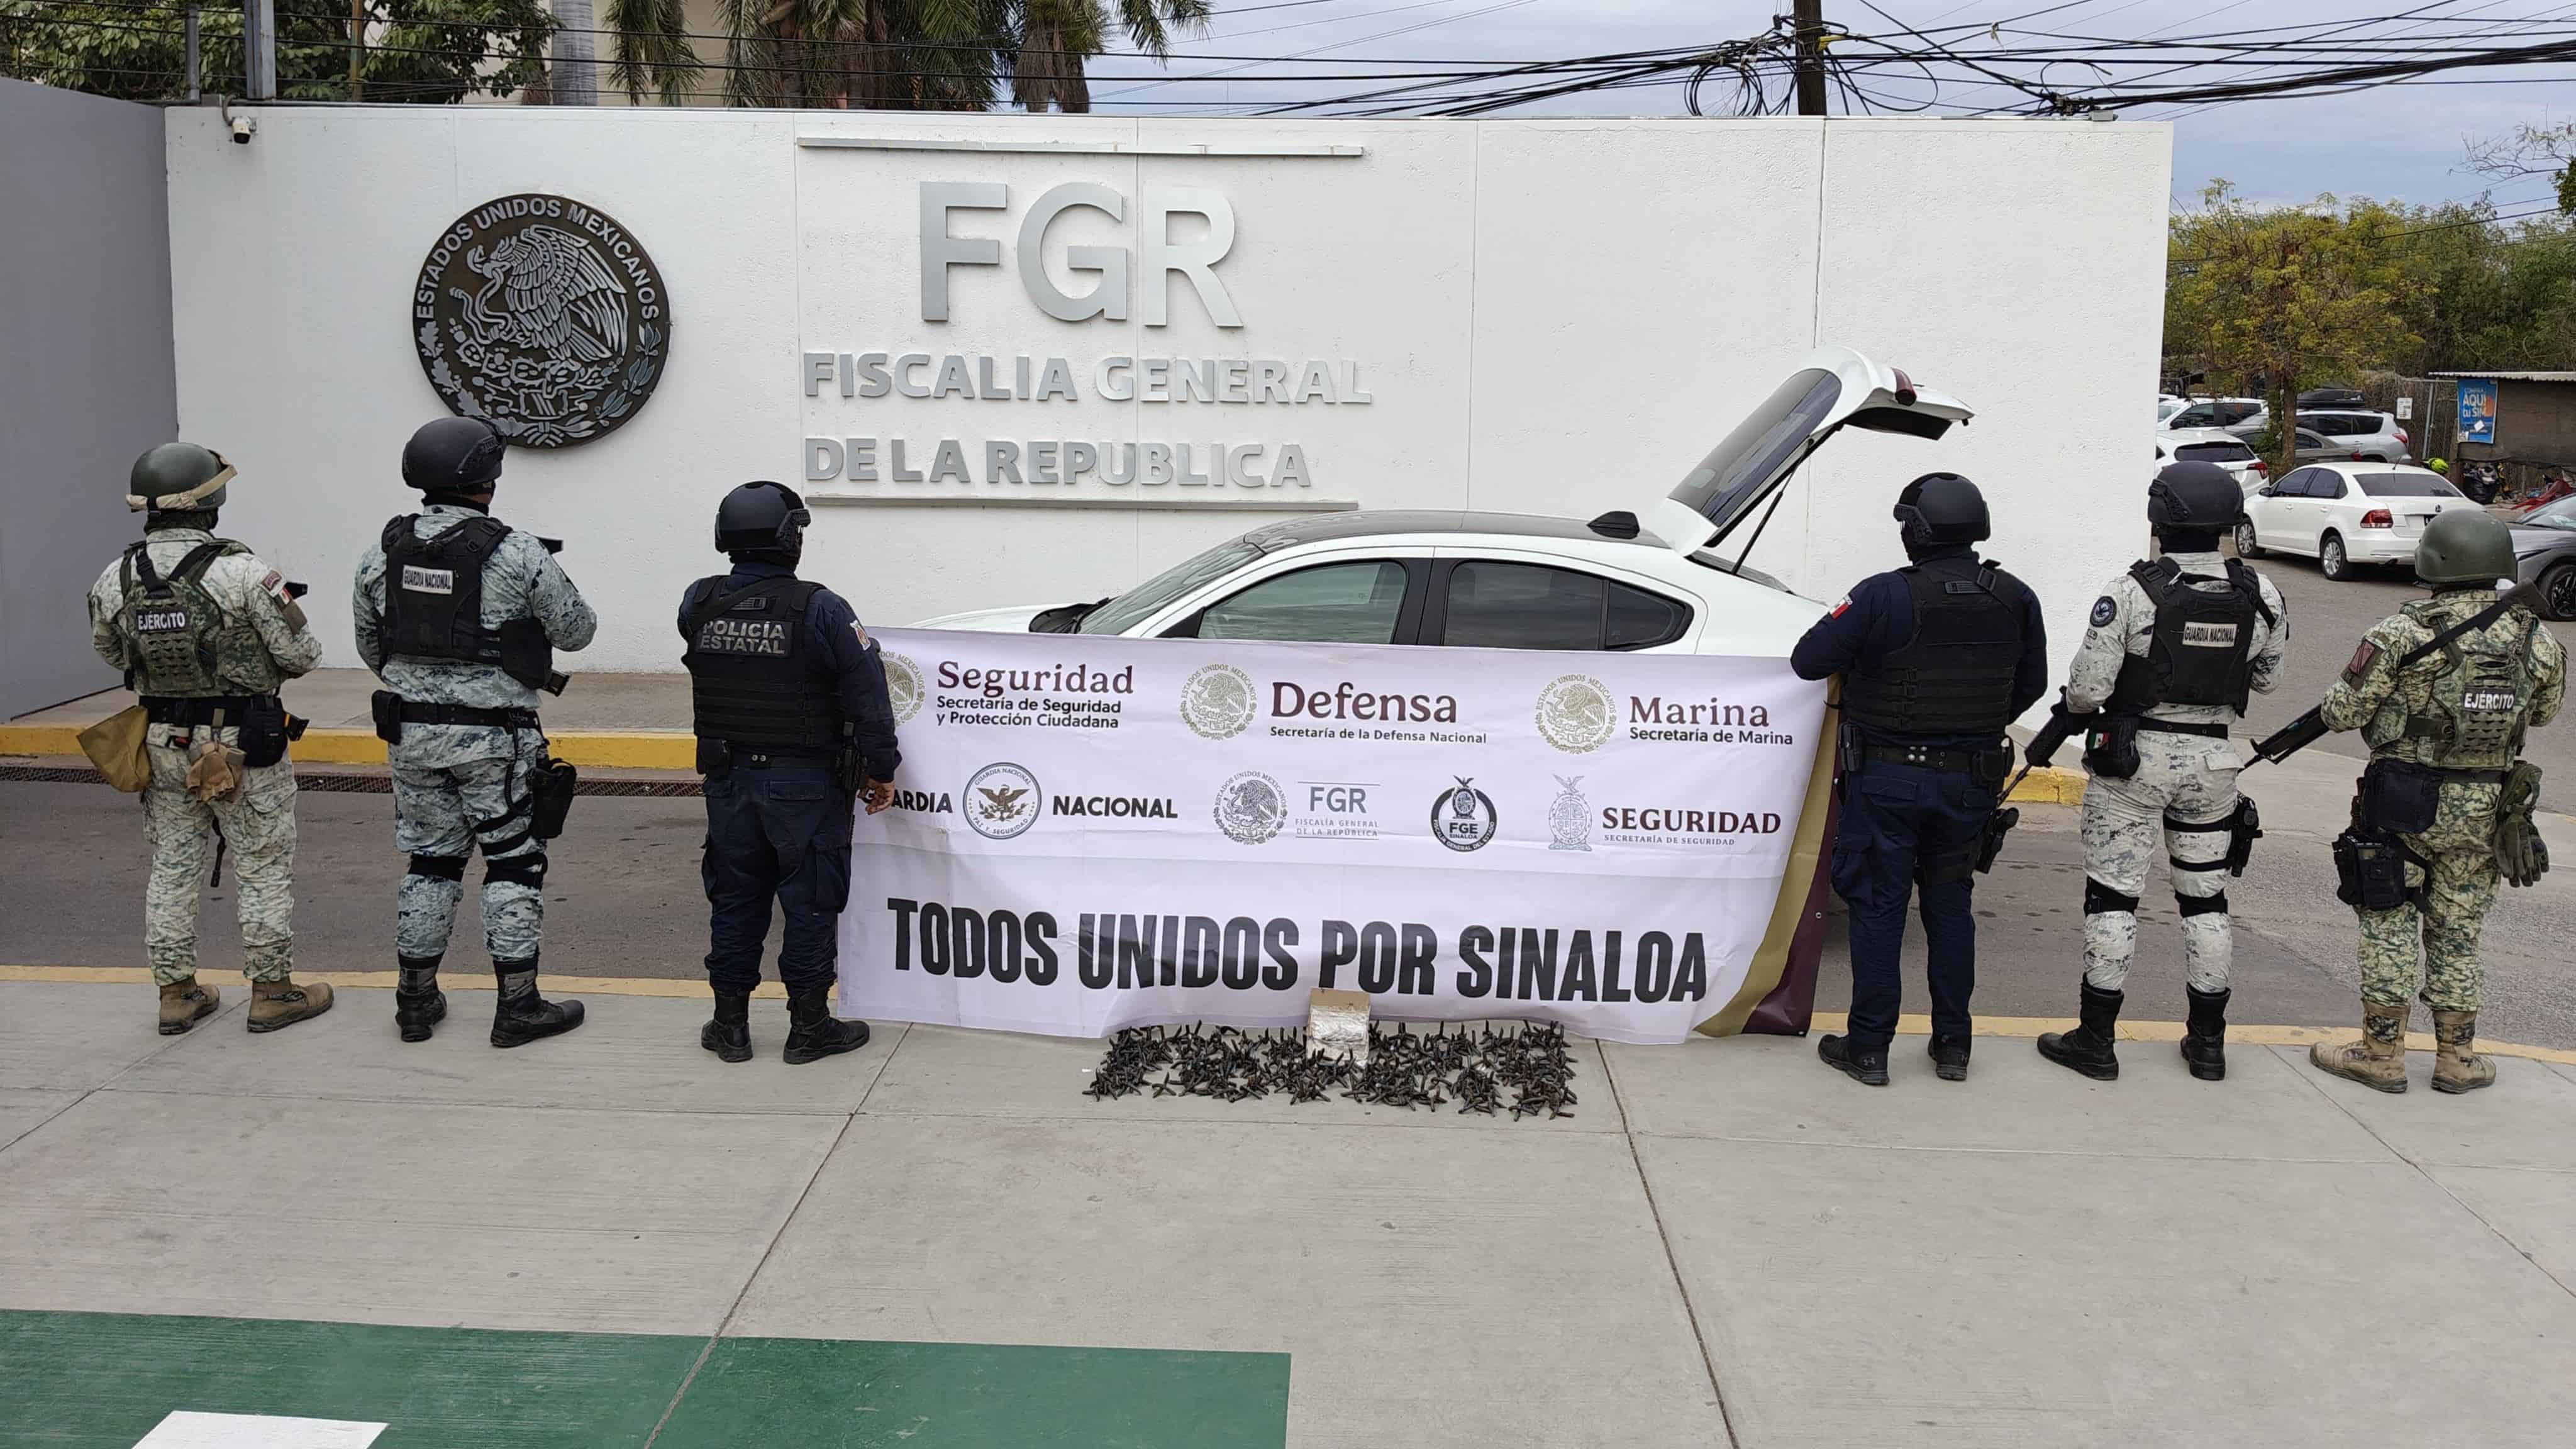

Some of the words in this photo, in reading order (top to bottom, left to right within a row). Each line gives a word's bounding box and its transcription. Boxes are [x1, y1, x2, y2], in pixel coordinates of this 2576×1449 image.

[416, 222, 474, 319] ESTADOS
[474, 197, 562, 230] UNIDOS
[567, 203, 660, 320] MEXICANOS
[919, 180, 1244, 328] FGR
[804, 352, 1078, 401] FISCALIA
[1095, 356, 1372, 404] GENERAL
[805, 436, 879, 481] DE
[891, 438, 970, 483] LA
[985, 439, 1311, 487] REPUBLICA
[404, 569, 423, 587] GUARDIA
[425, 573, 451, 589] NACIONAL
[138, 610, 186, 630] EJÉRCITO
[2184, 626, 2209, 642] GUARDIA
[2209, 628, 2234, 643] NACIONAL
[700, 635, 786, 655] ESTATAL
[1202, 663, 1229, 674] UNIDOS
[937, 660, 1134, 698] Seguridad
[1557, 674, 1586, 684] UNIDOS
[936, 695, 1014, 711] Secretaría
[1018, 697, 1038, 711] de
[1042, 698, 1121, 714] Seguridad
[1270, 681, 1457, 723] Defensa
[2464, 689, 2514, 710] EJÉRCITO
[936, 713, 945, 726] y
[950, 711, 1032, 726] Protección
[1037, 713, 1119, 728] Ciudadana
[1629, 696, 1770, 728] Marina
[1270, 726, 1335, 738] Secretaría
[1339, 728, 1355, 739] de
[1358, 728, 1370, 740] la
[1374, 729, 1426, 742] Defensa
[1430, 731, 1487, 744] Nacional
[1629, 726, 1709, 742] Secretaría
[1713, 729, 1734, 743] de
[1738, 730, 1793, 745] Marina
[974, 768, 1001, 786] GUARDIA
[1002, 767, 1031, 786] NACIONAL
[865, 787, 953, 814] GARDIA
[1052, 795, 1178, 819] NACIONAL
[1310, 786, 1367, 814] FGR
[992, 818, 1028, 835] SEGURIDAD
[1338, 819, 1379, 828] GENERAL
[1449, 822, 1479, 835] FGE
[1602, 806, 1781, 834] SEGURIDAD
[1604, 834, 1663, 844] SECRETARÍA
[1666, 836, 1678, 845] DE
[1681, 837, 1735, 846] SEGURIDAD
[887, 897, 1058, 986] TODOS
[1079, 913, 1299, 991] UNIDOS
[1319, 919, 1438, 996] POR
[1456, 926, 1707, 1004] SINALOA
